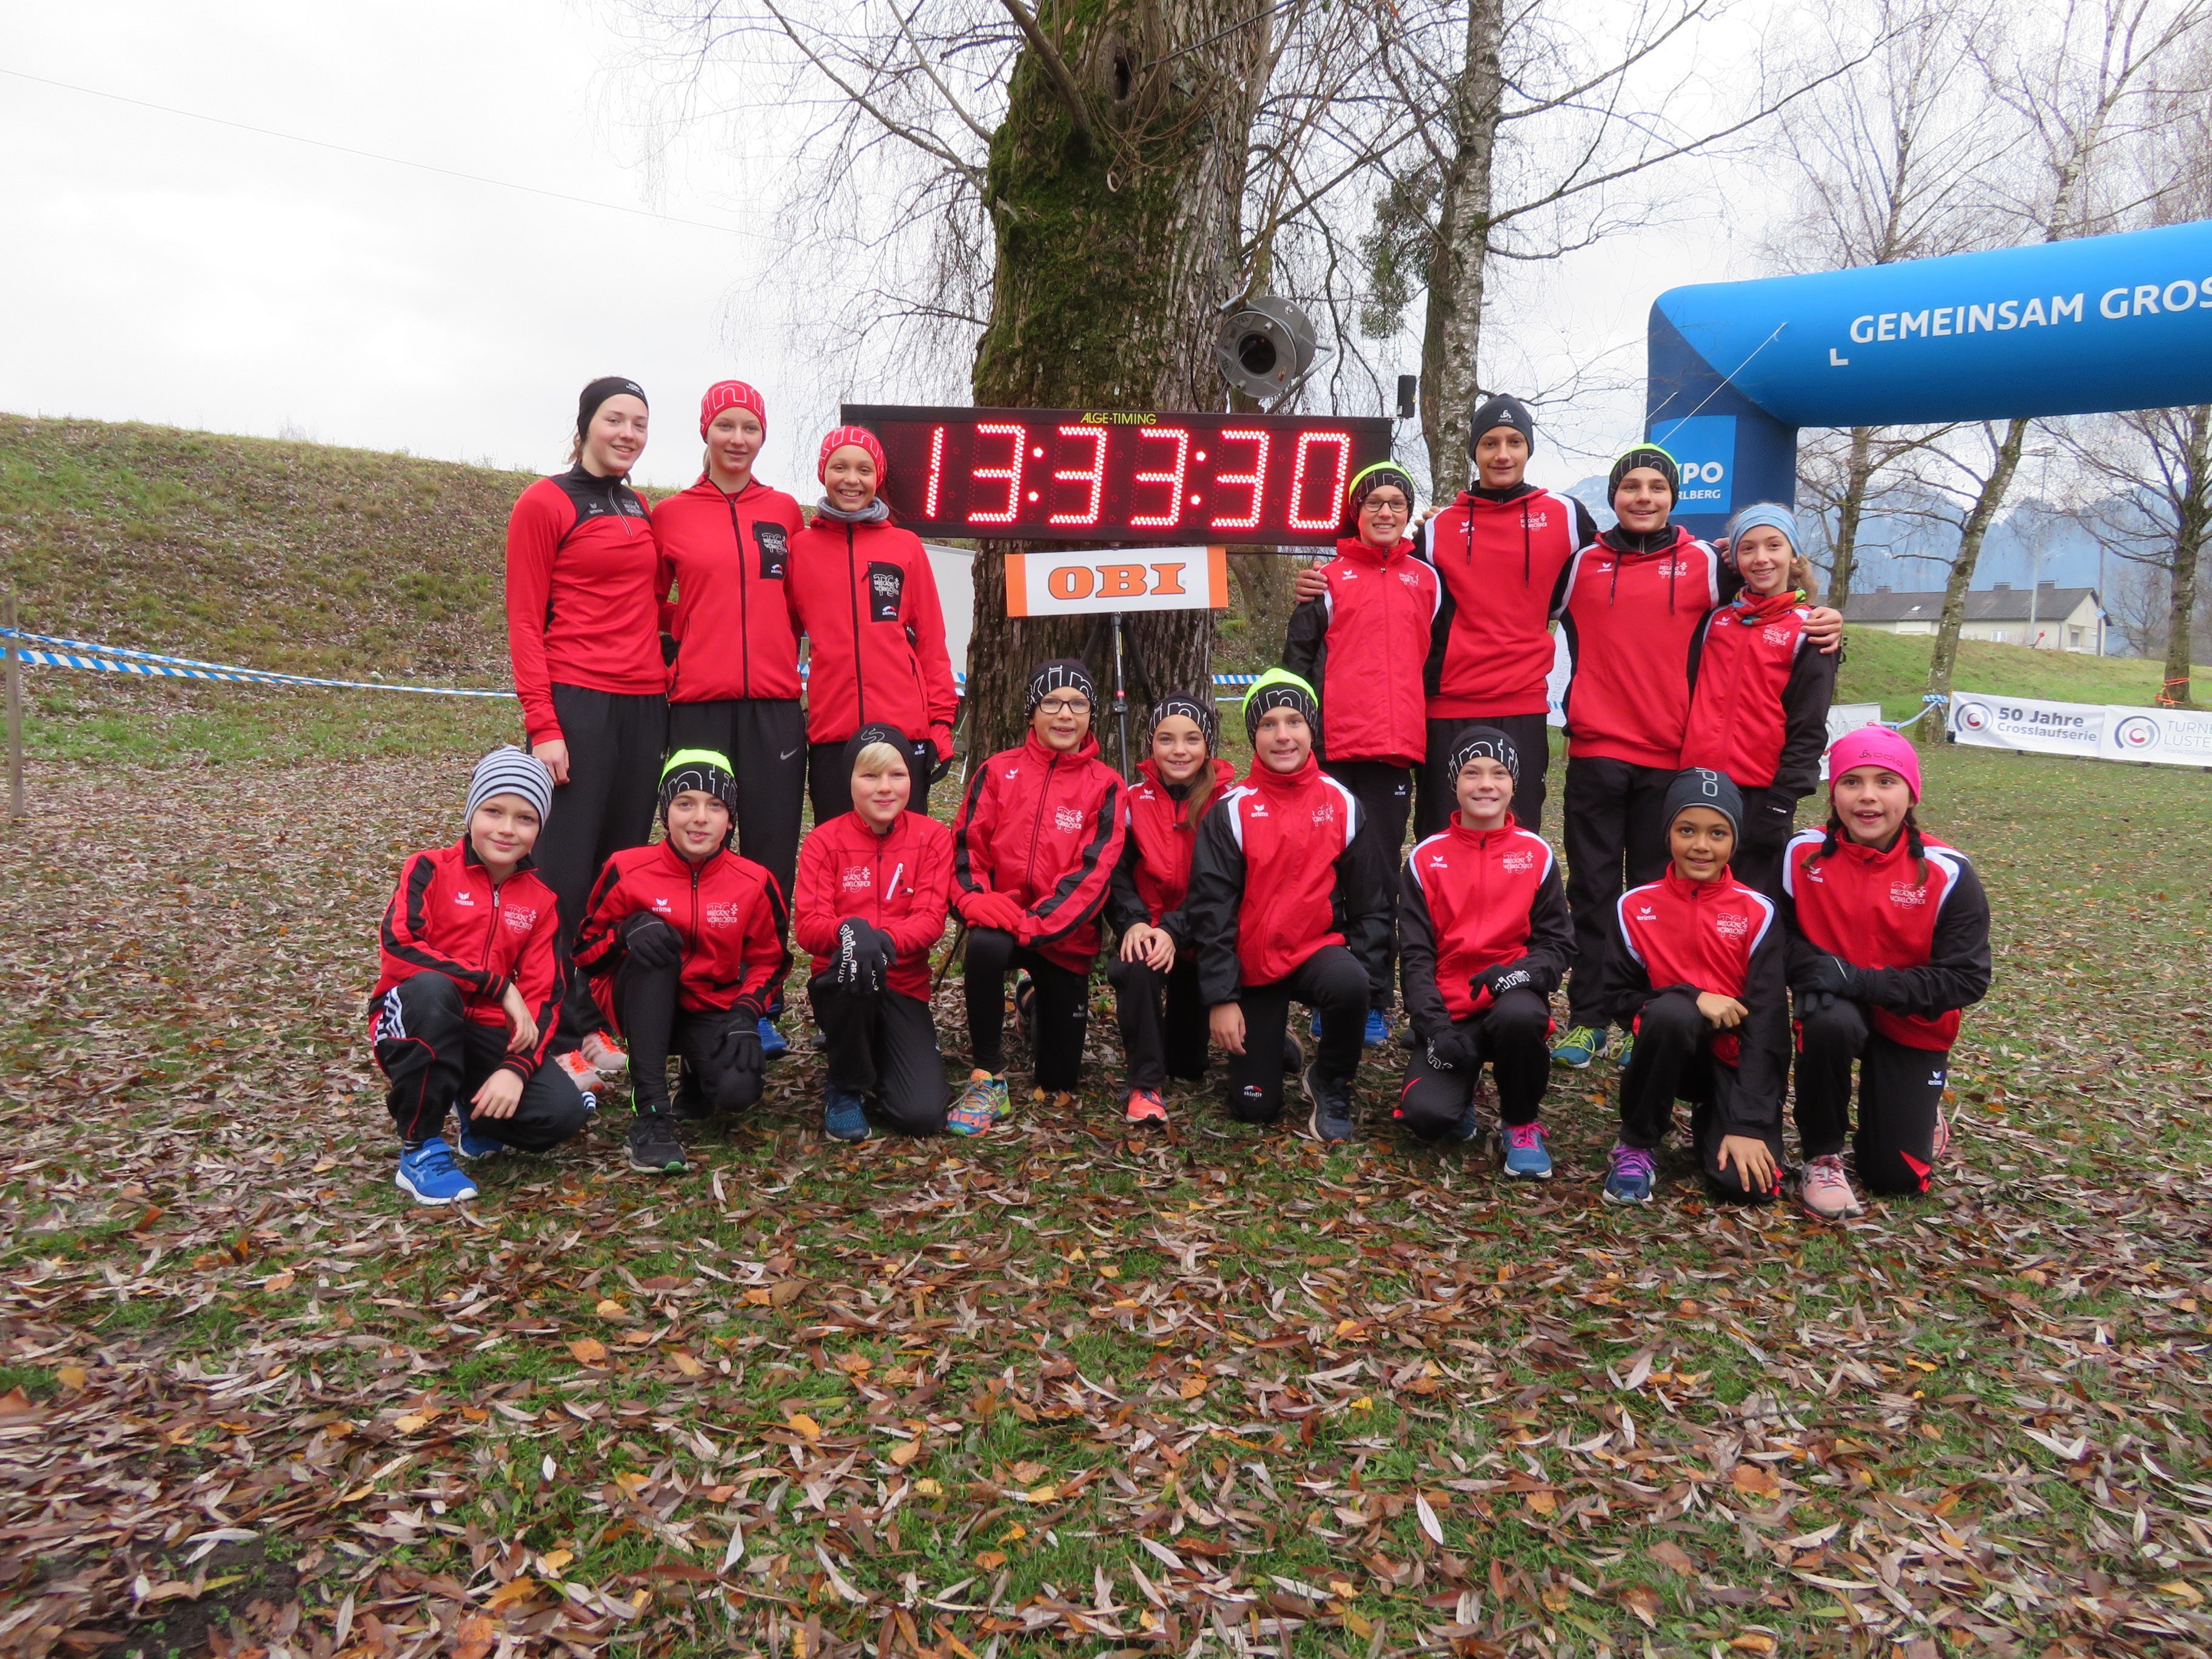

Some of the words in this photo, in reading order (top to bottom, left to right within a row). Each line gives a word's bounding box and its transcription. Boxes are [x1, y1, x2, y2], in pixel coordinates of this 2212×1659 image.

[1850, 292, 2084, 344] GEMEINSAM
[1080, 412, 1157, 425] ALGE-TIMING
[1048, 563, 1187, 600] OBI
[1998, 707, 2023, 722] 50
[2029, 711, 2084, 728] Jahre
[1997, 722, 2097, 742] Crosslaufserie
